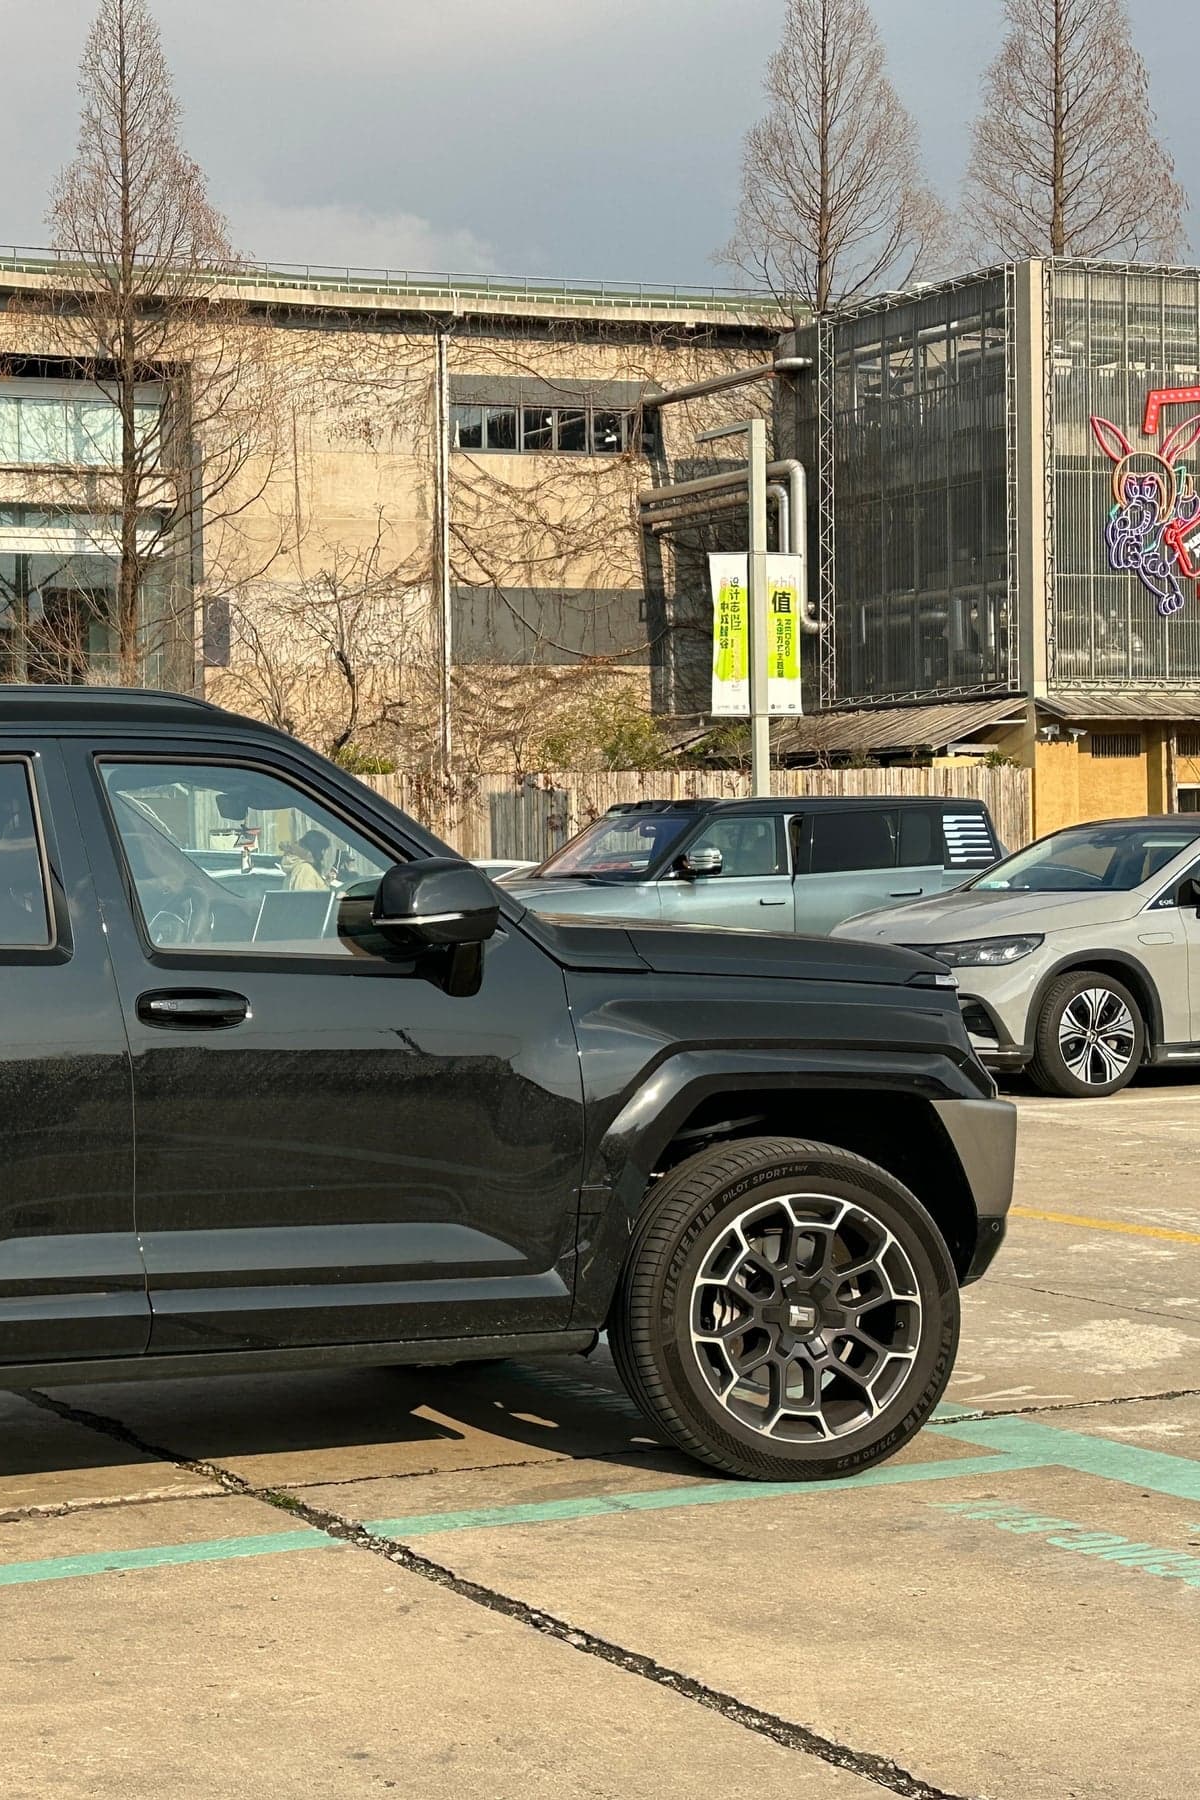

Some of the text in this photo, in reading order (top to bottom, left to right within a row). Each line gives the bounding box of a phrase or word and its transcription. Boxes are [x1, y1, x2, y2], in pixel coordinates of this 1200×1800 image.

[771, 590, 791, 614] 值
[662, 1204, 716, 1305] MICHELIN
[722, 1180, 750, 1204] PILOT
[752, 1167, 788, 1185] SPORT
